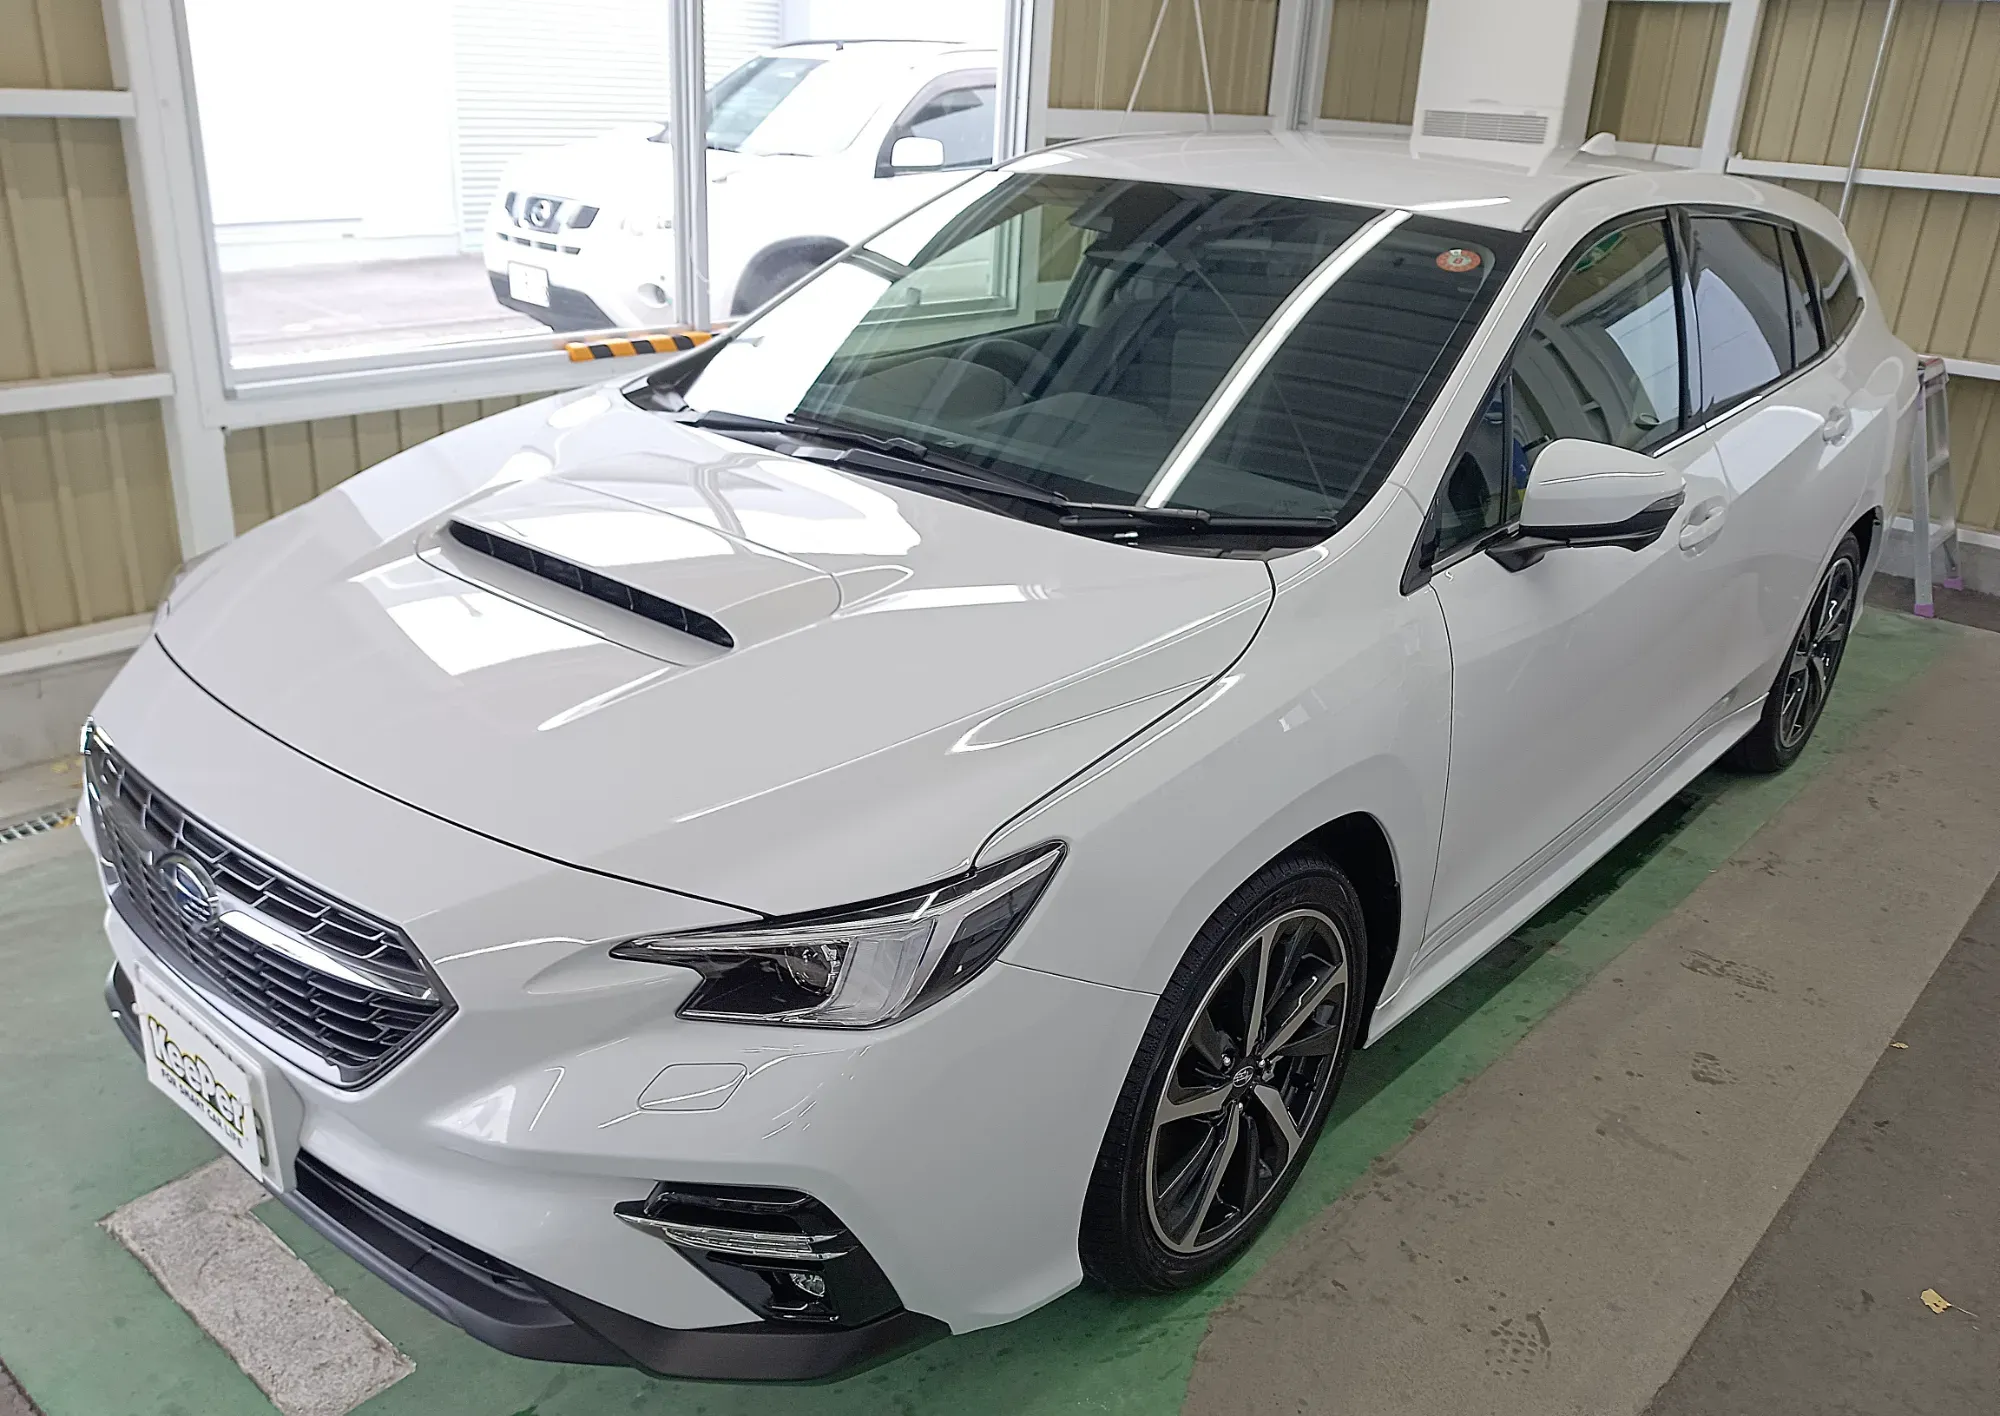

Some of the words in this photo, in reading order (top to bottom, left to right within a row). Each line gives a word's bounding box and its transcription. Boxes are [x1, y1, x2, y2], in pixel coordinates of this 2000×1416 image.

[149, 1015, 246, 1135] KeePer
[161, 1069, 177, 1089] FOR
[180, 1082, 205, 1112] SMART
[207, 1109, 223, 1129] CAR
[225, 1125, 243, 1148] LIFE
